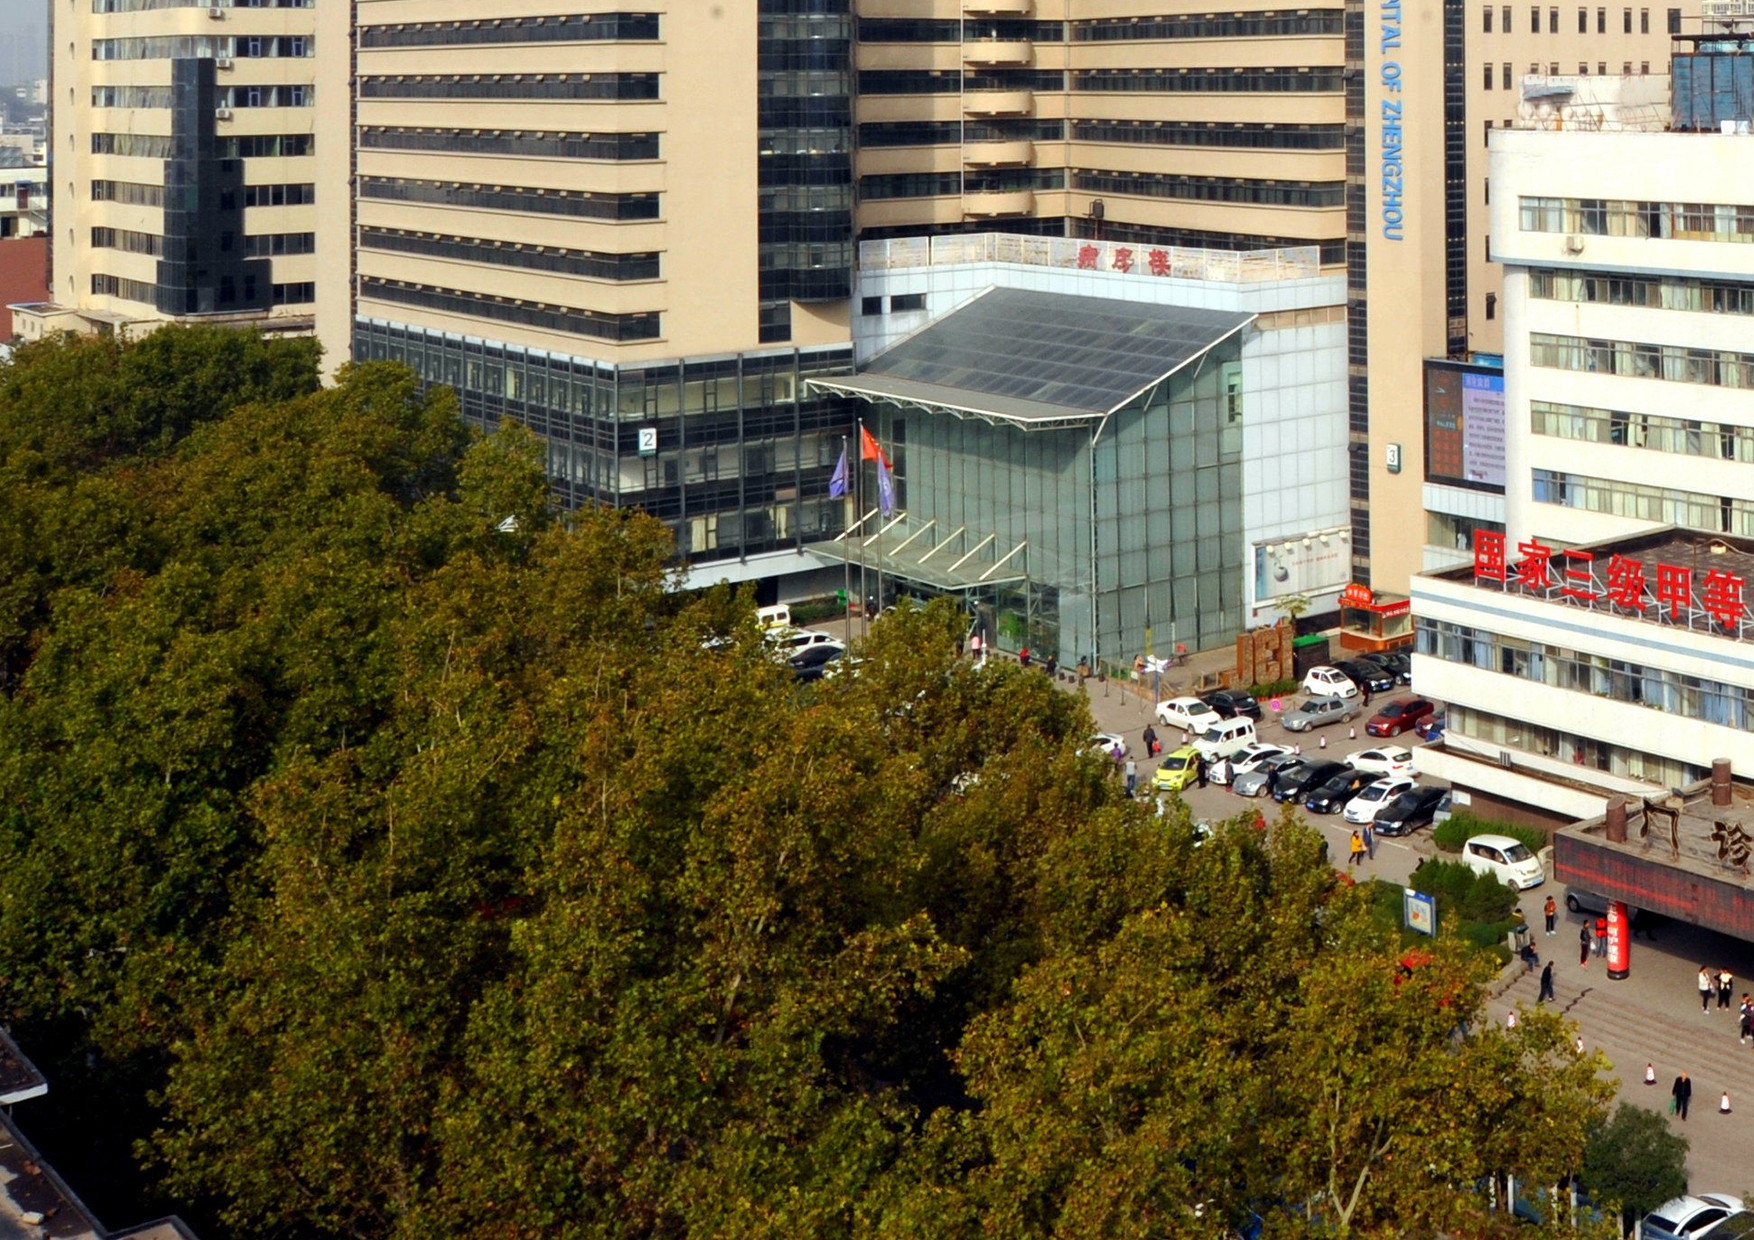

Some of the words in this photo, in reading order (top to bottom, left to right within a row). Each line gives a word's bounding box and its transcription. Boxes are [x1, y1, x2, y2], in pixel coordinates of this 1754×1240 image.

[1381, 62, 1402, 91] OF
[1381, 100, 1404, 242] ZHENGZHOU
[643, 432, 653, 447] 2
[1389, 449, 1396, 463] 3
